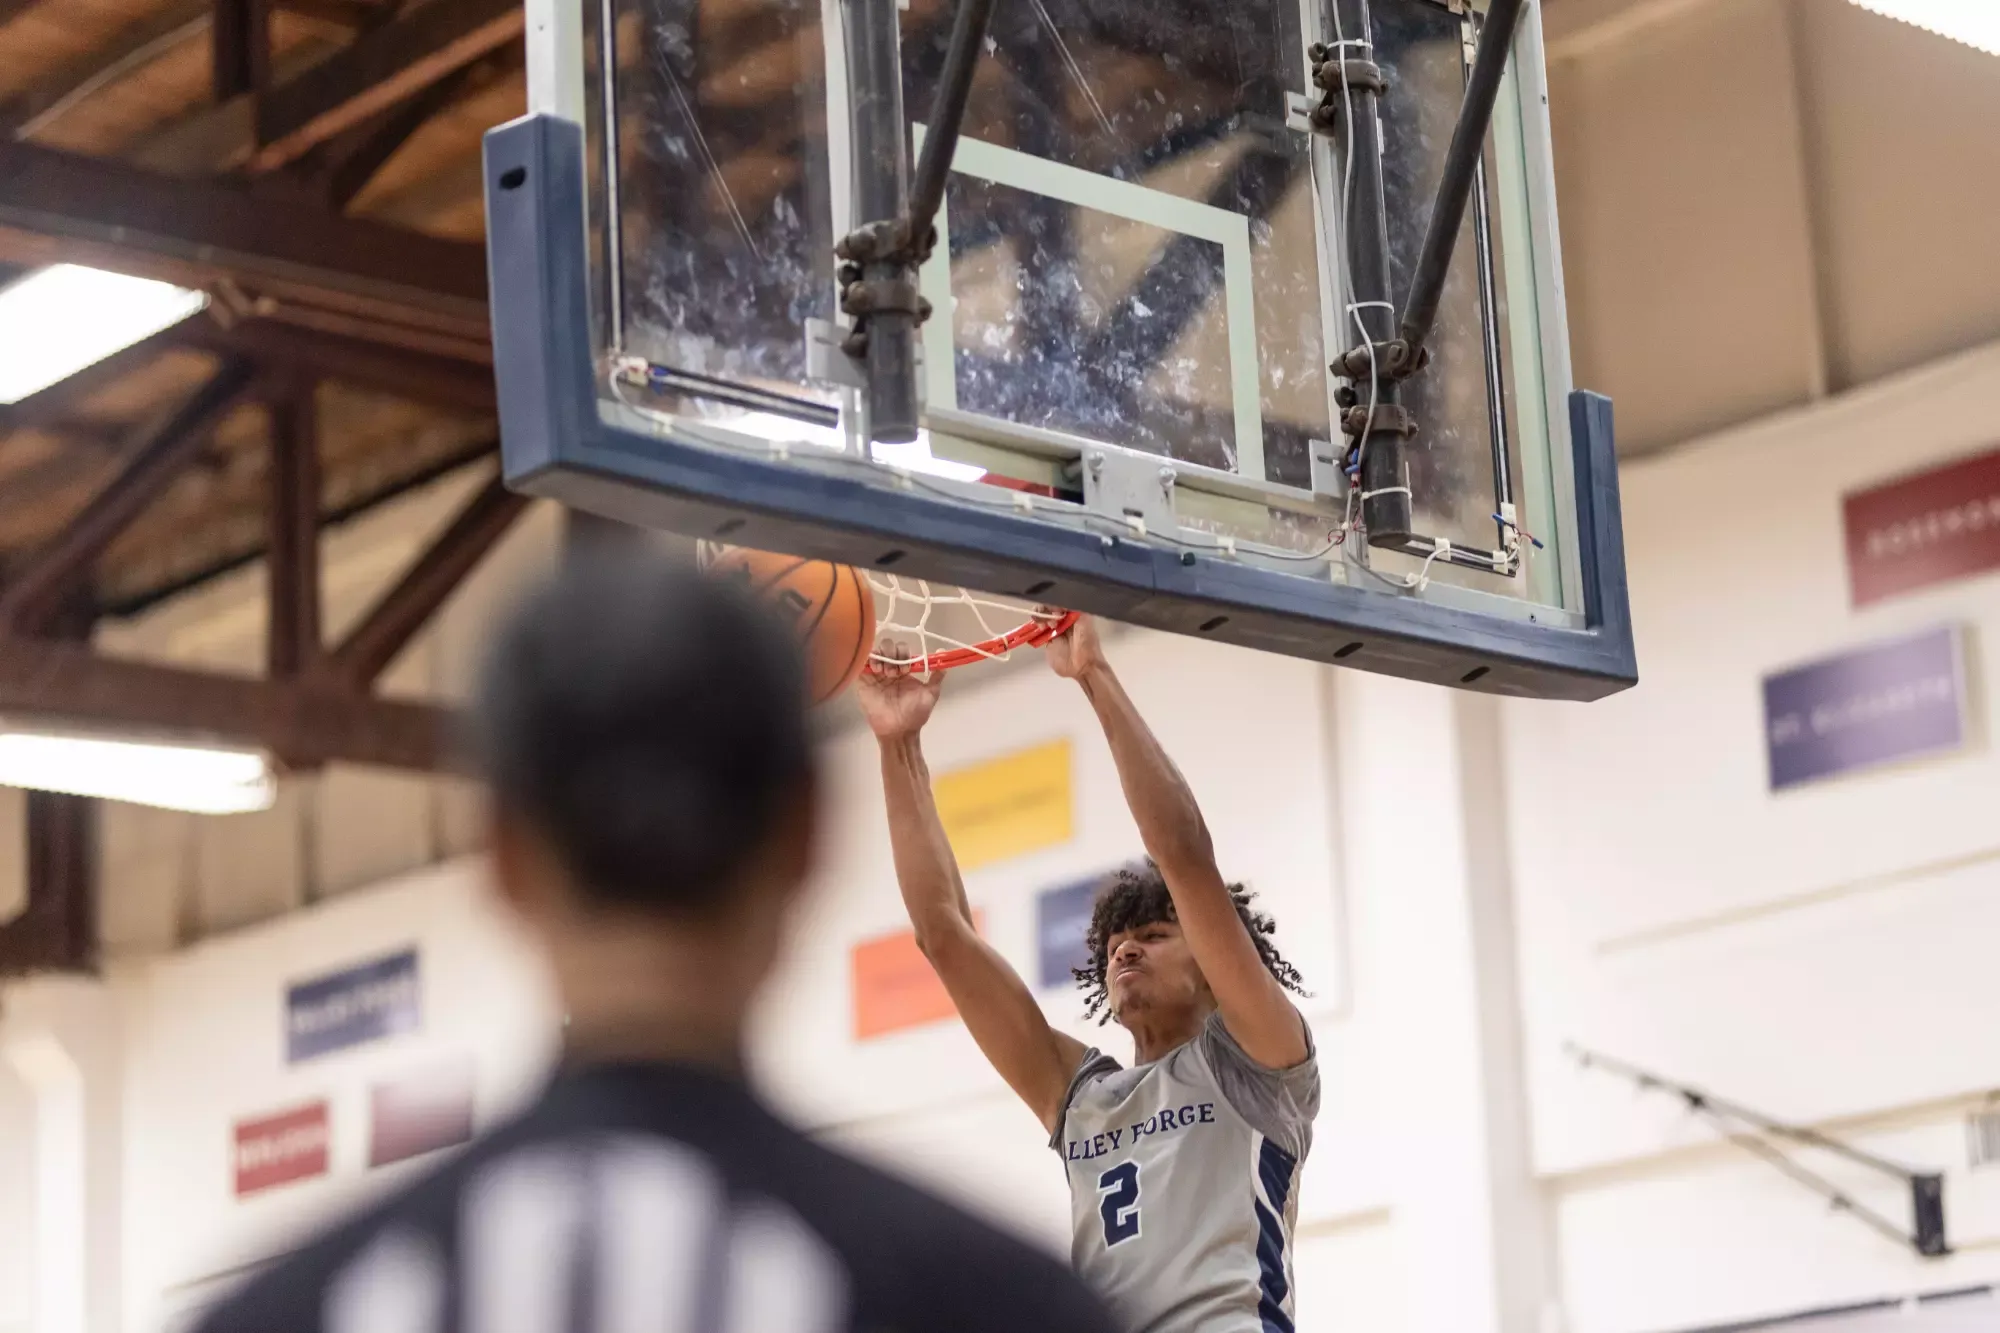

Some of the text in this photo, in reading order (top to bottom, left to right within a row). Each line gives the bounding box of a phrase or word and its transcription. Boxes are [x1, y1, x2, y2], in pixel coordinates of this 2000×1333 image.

[1065, 1103, 1215, 1161] LLEY FORGE
[1097, 1159, 1142, 1249] 2
